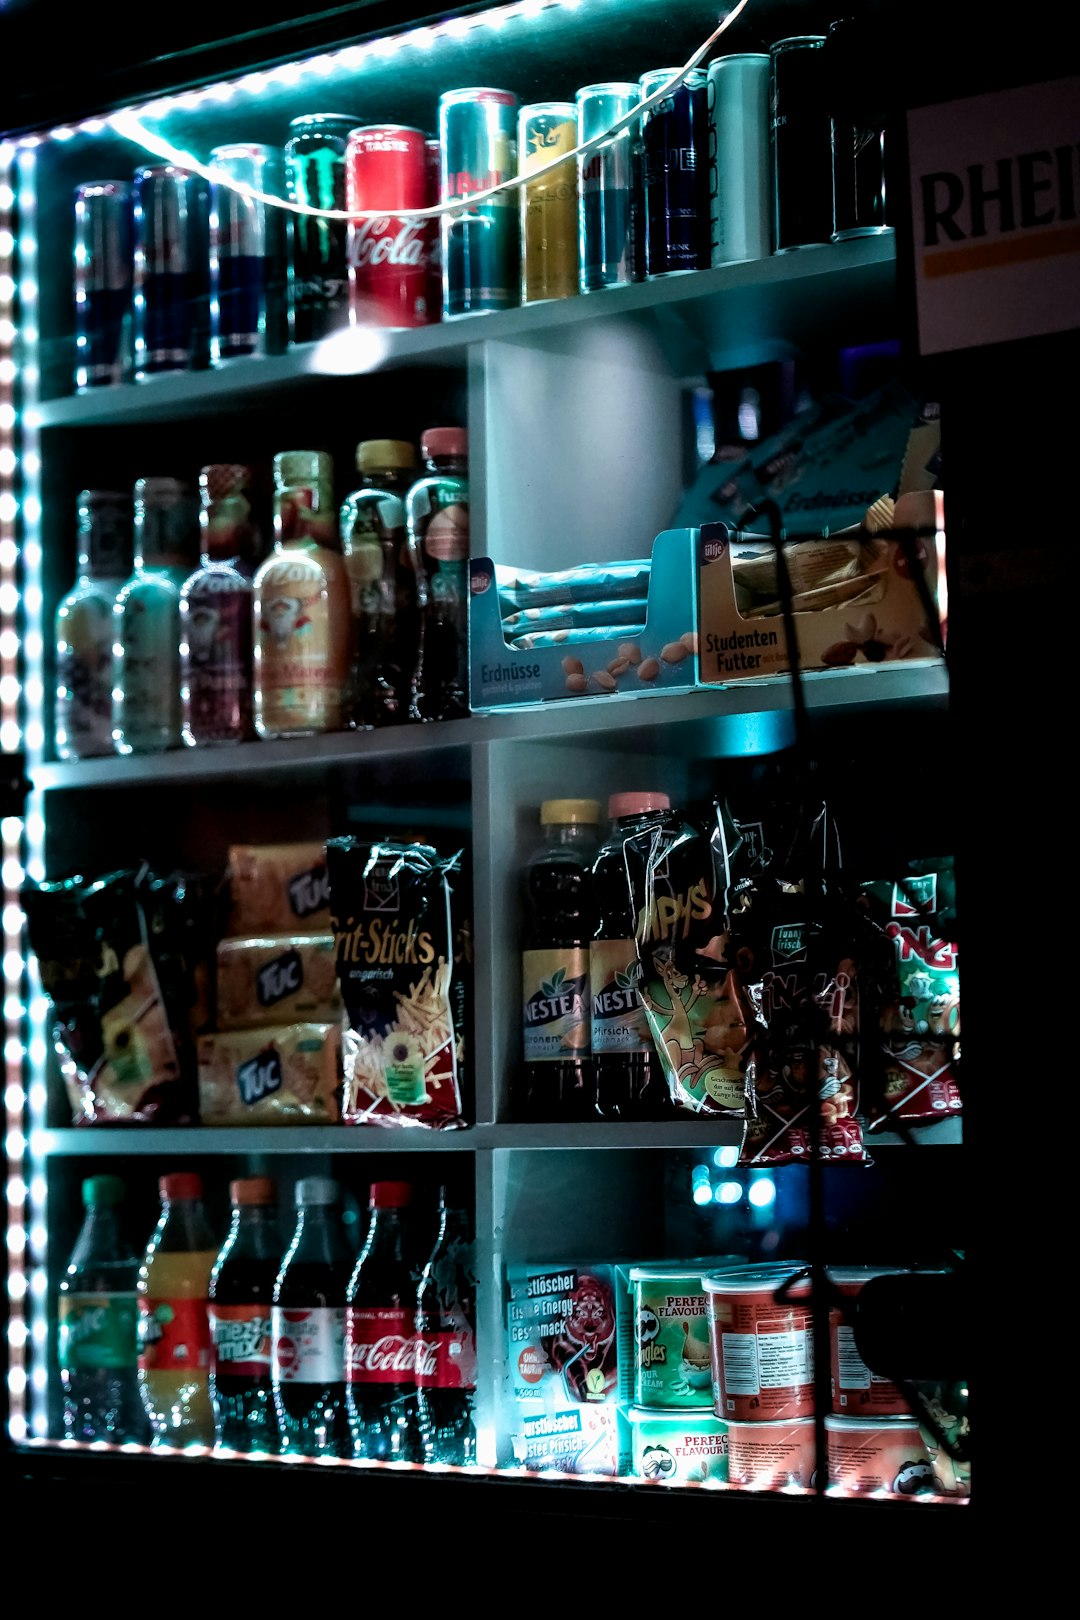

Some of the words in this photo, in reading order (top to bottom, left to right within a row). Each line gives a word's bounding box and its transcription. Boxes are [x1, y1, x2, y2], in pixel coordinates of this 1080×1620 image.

[364, 139, 410, 153] TASTE
[920, 143, 1080, 247] RHEI
[347, 215, 429, 268] Cola
[706, 629, 777, 652] Studenten
[481, 662, 541, 683] Erdnüsse
[717, 652, 762, 673] Futter
[348, 967, 394, 982] ungarisch
[525, 994, 585, 1021] NESTEA
[542, 1299, 578, 1317] Energy-
[659, 1307, 706, 1317] FLAVOUR
[667, 1296, 708, 1307] PERFE
[511, 1319, 567, 1342] Gesmack
[675, 1446, 723, 1457] FLAVOUR
